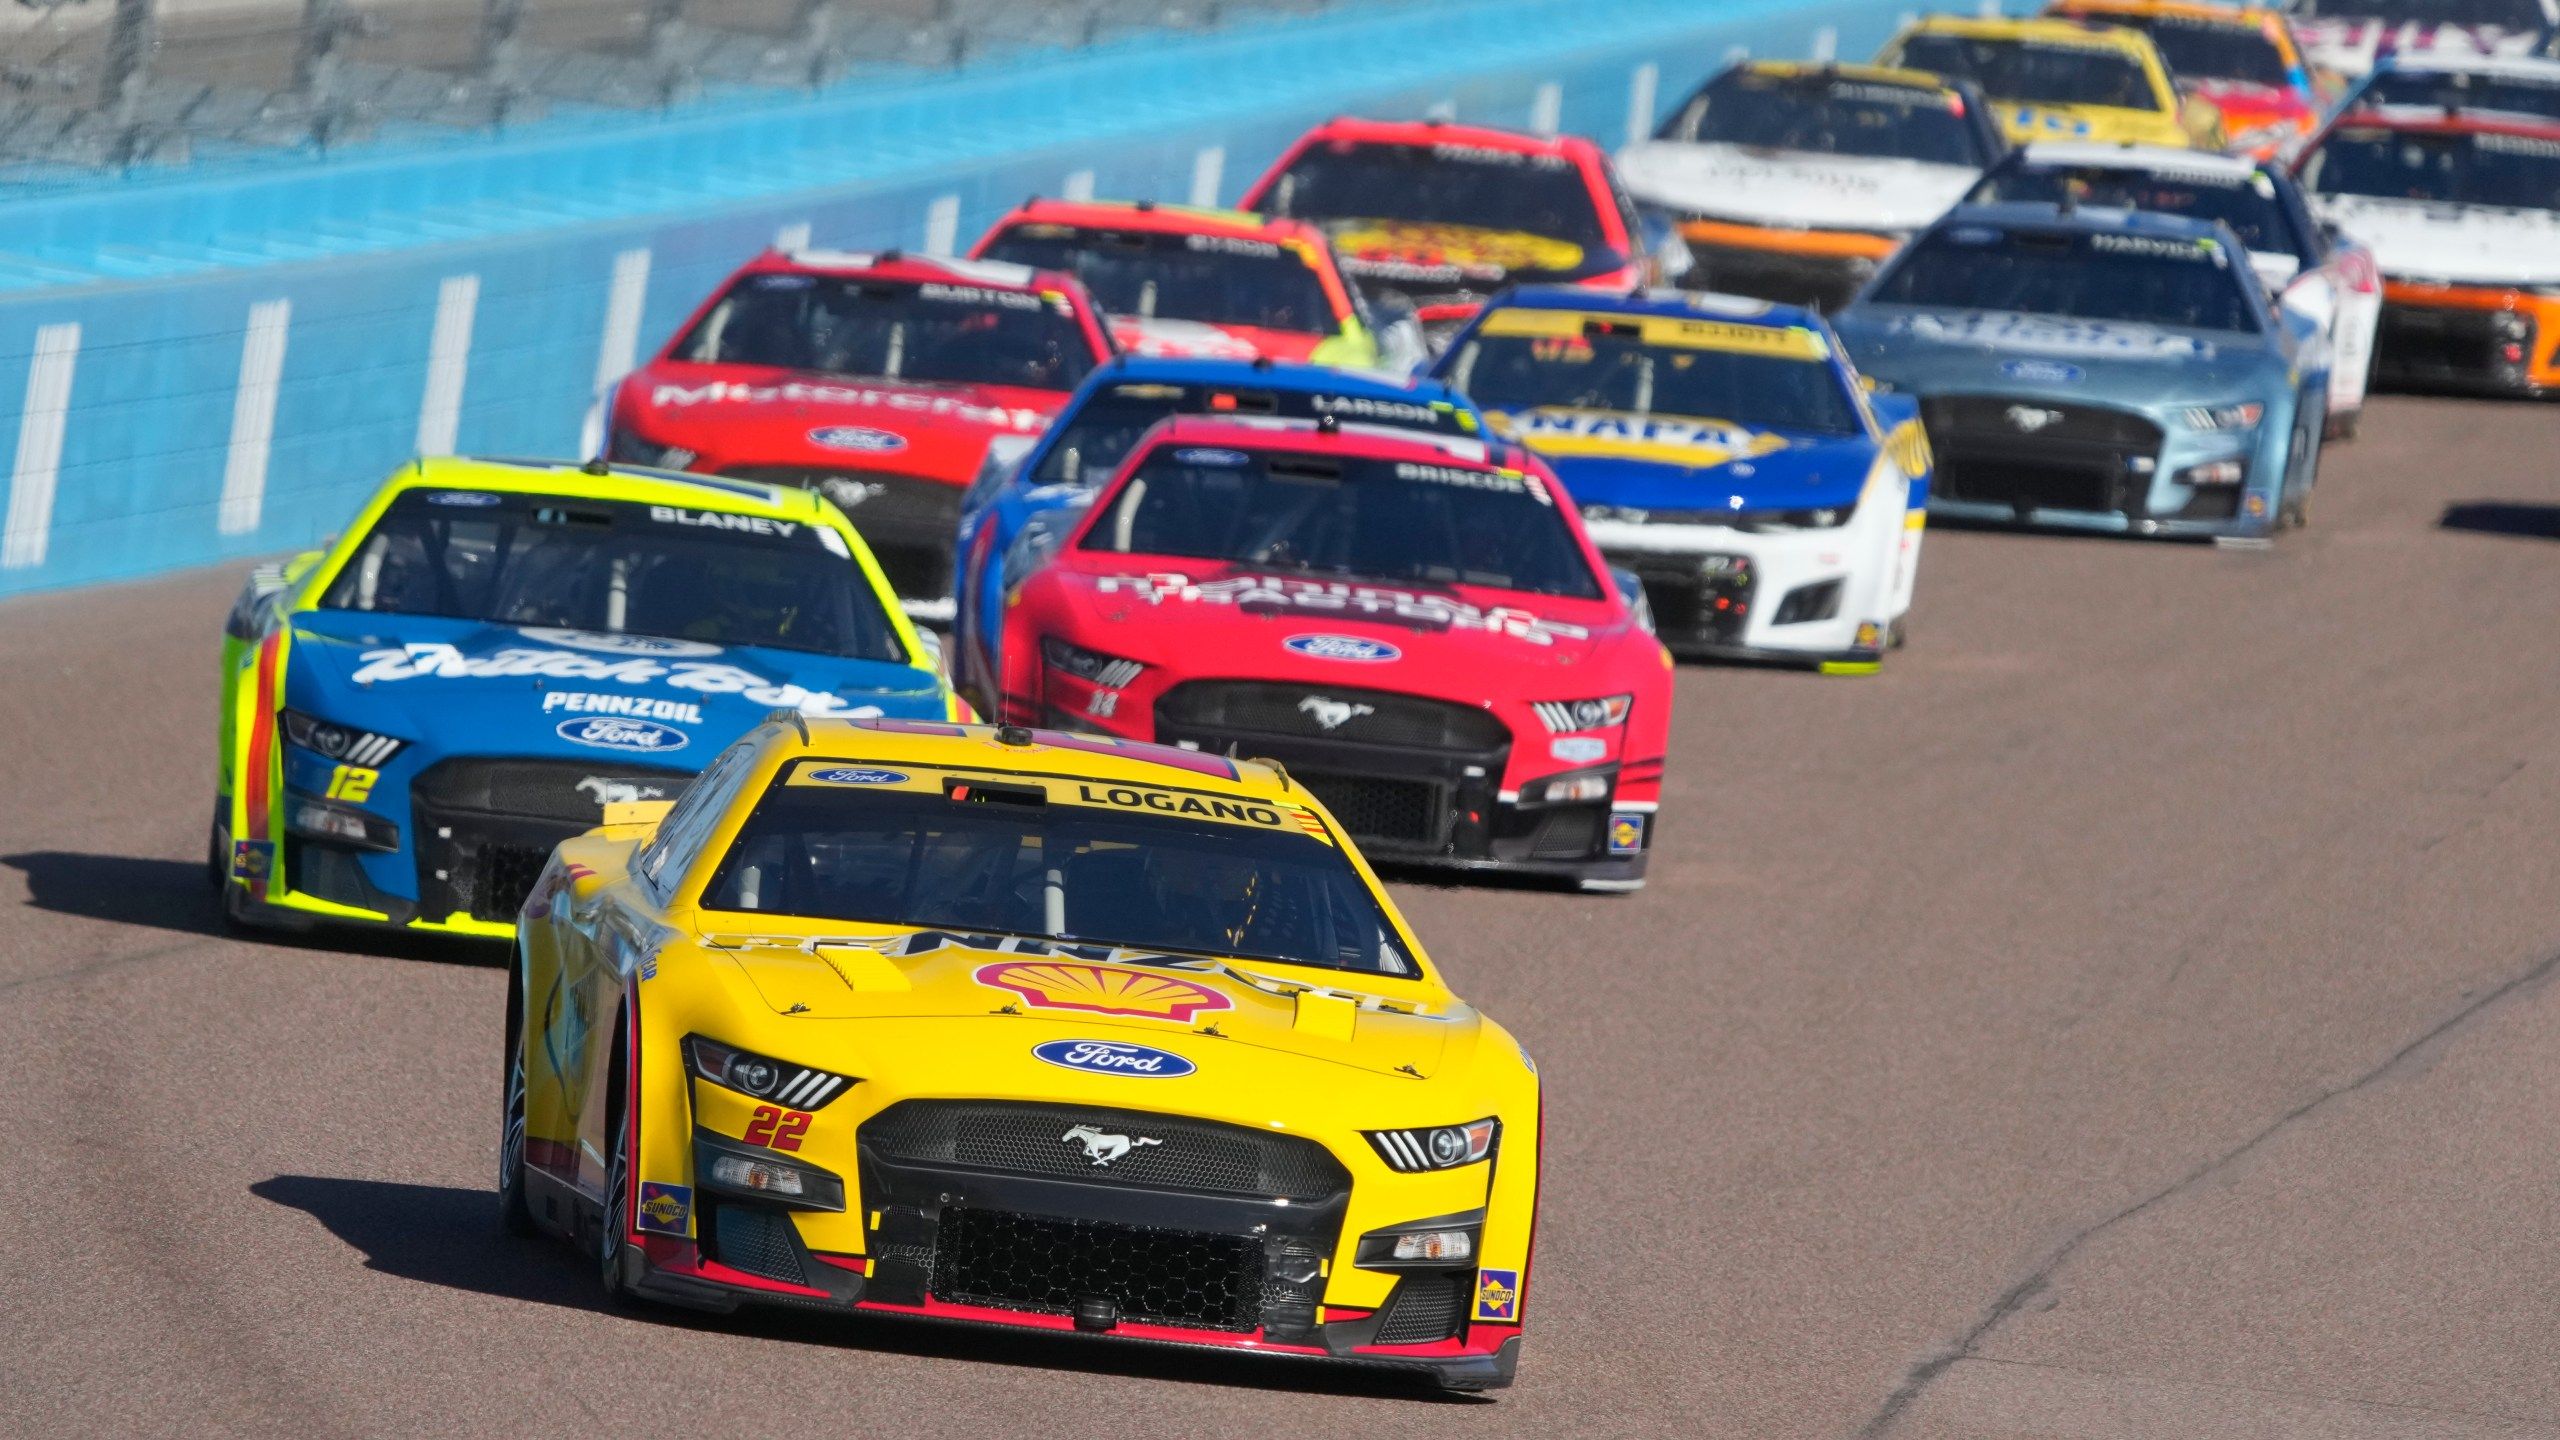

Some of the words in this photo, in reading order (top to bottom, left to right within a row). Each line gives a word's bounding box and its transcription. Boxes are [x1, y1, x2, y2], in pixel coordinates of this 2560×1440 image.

[1312, 395, 1437, 423] LARSON
[650, 506, 797, 538] BLANEY
[543, 692, 703, 724] PENNZOIL
[325, 765, 380, 803] 12
[1080, 784, 1281, 826] LOGANO
[1062, 1041, 1163, 1075] Ford
[743, 1105, 813, 1152] 22
[644, 1201, 687, 1217] SUNOCO
[1481, 1289, 1512, 1302] SUNOCO
